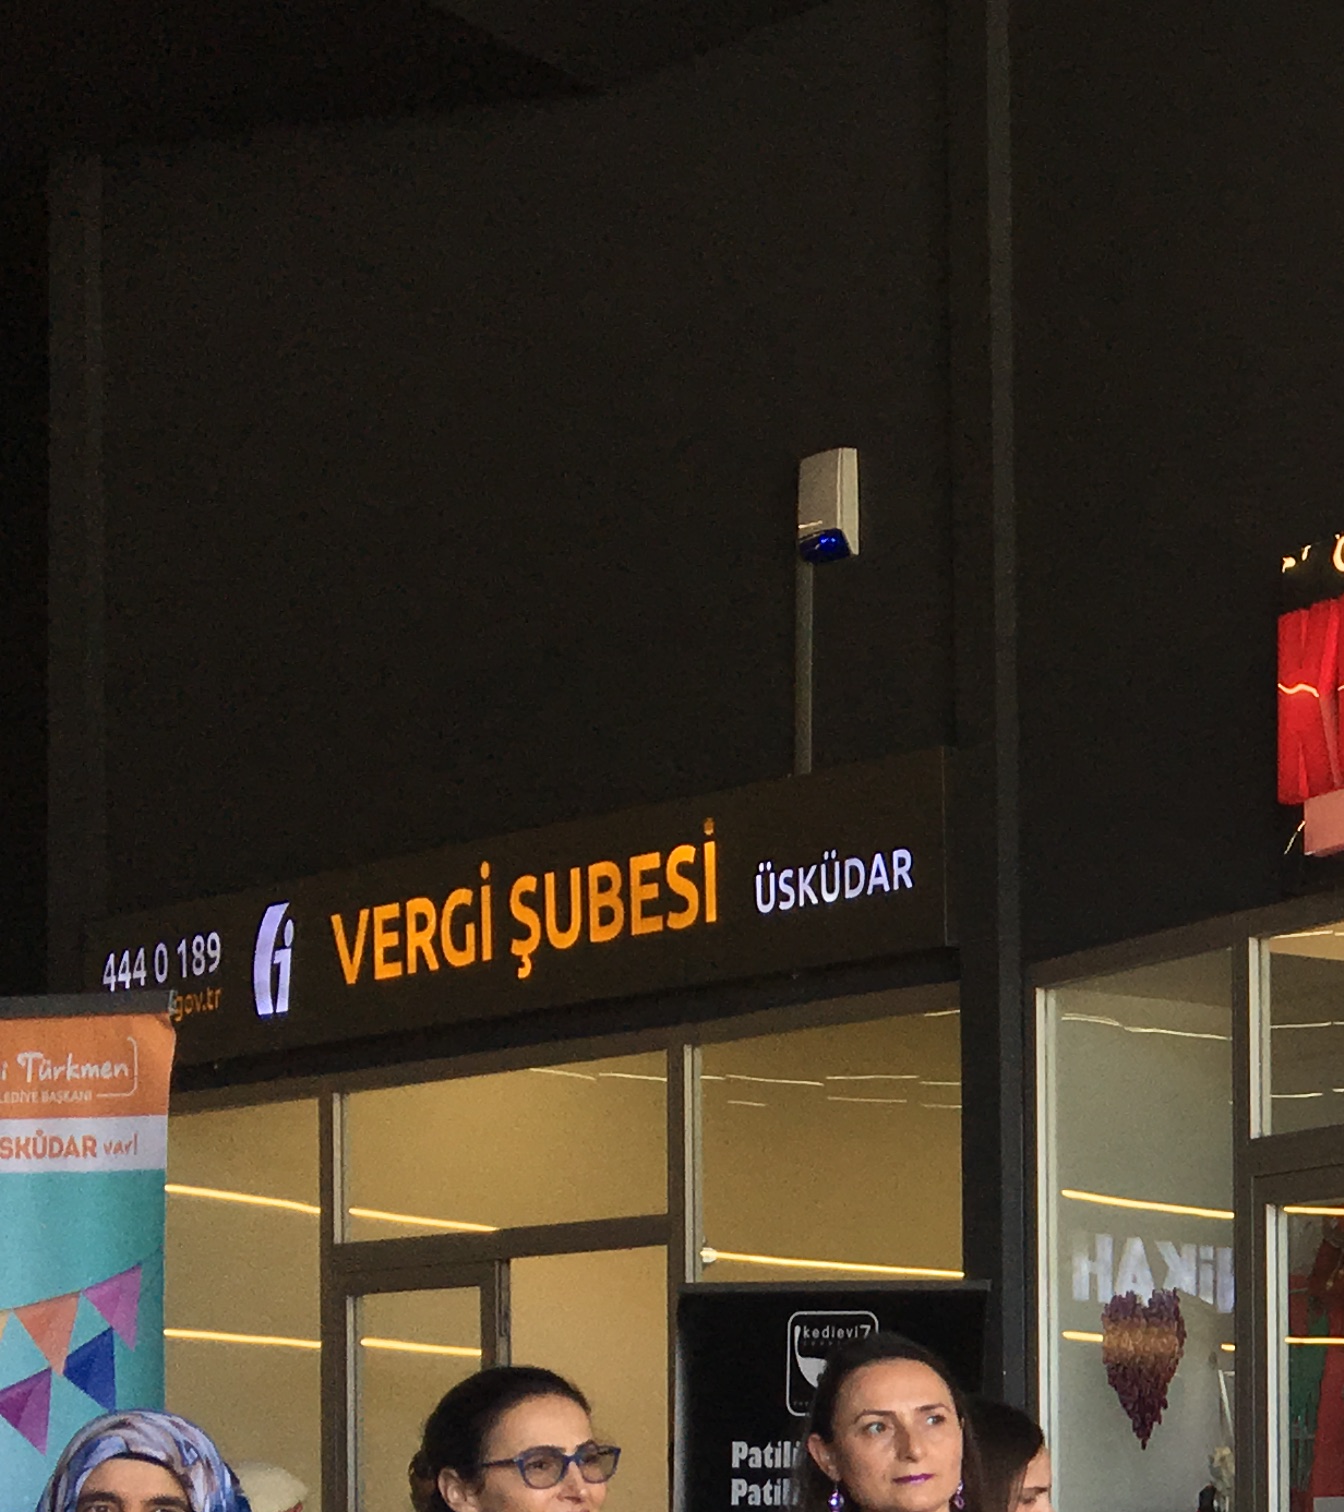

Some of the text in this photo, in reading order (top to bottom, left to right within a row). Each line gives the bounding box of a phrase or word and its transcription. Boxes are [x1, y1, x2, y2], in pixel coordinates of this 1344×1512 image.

[331, 817, 914, 985] VERGİ ŞUBESİ ÜSKÜDAR
[103, 931, 221, 992] 444 0 189
[17, 1051, 129, 1083] Türkmen
